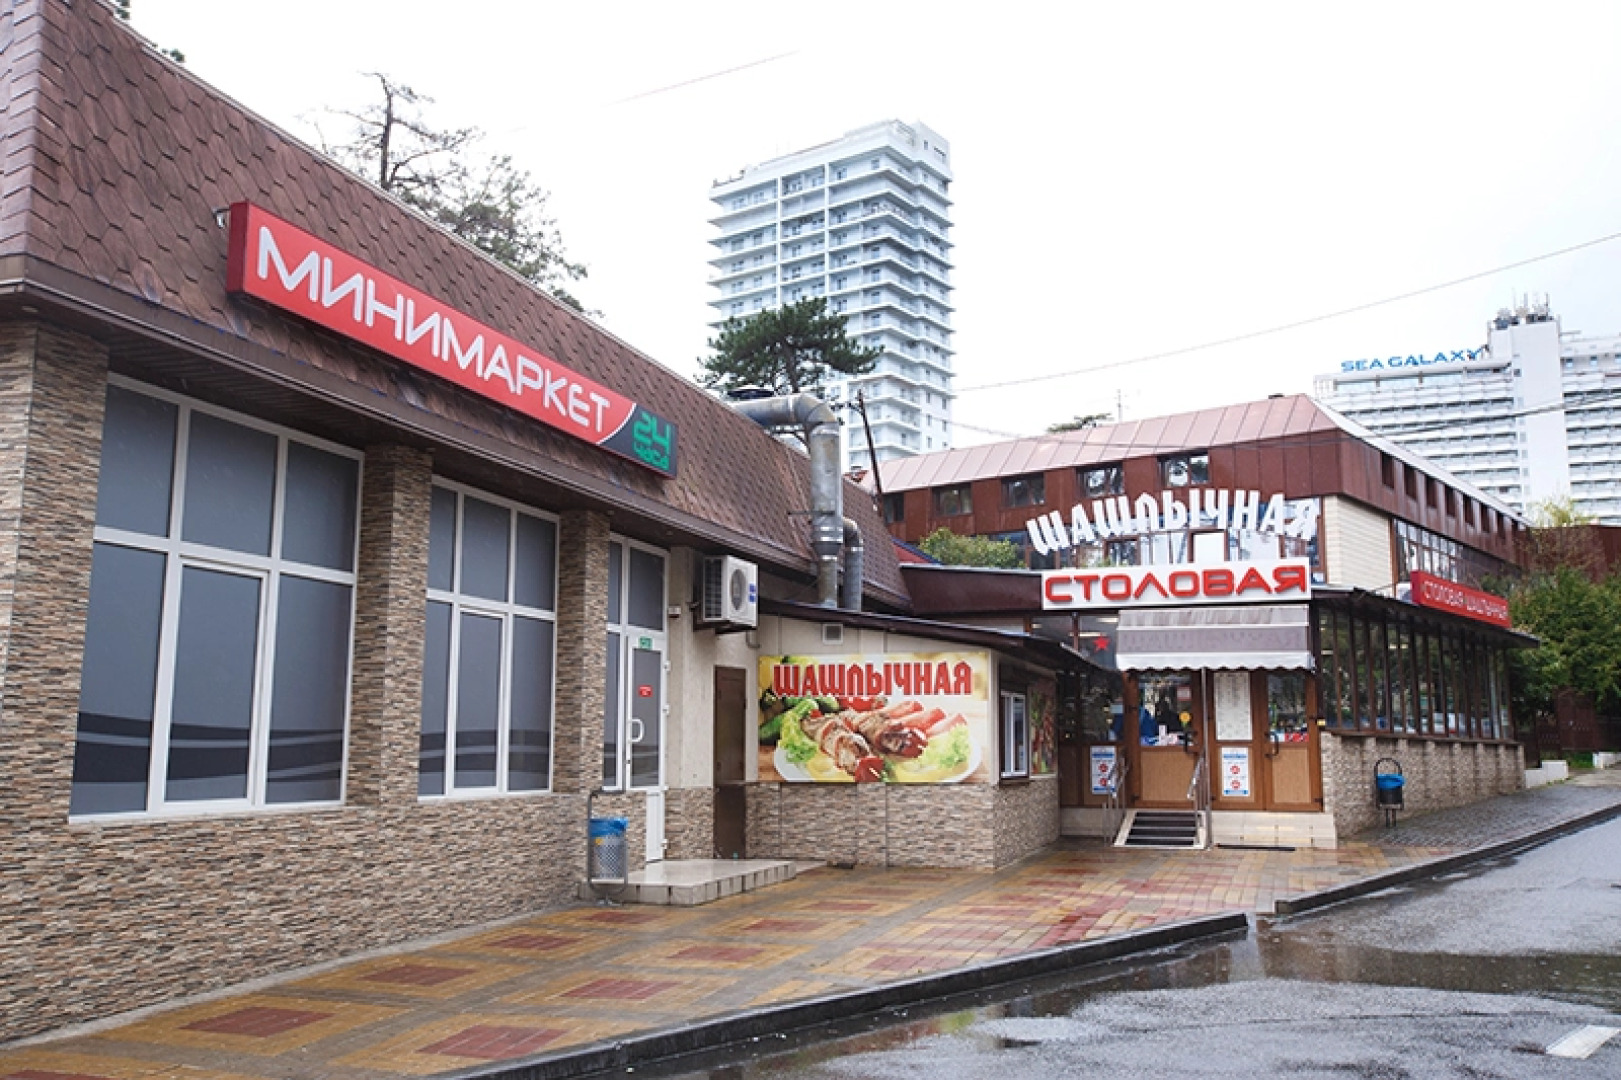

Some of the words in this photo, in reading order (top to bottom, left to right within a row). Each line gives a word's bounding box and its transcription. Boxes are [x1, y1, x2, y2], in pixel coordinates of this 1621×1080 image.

[257, 226, 611, 433] МИНИМАРКЕТ
[1341, 358, 1385, 373] SEA
[1387, 347, 1483, 368] GALAXY
[633, 411, 671, 456] 24
[1026, 488, 1320, 555] ШАШЛЫЧНАЯ
[1045, 565, 1307, 601] СТОЛОВАЯ
[773, 660, 972, 696] ШАШЛЫЧНАЯ
